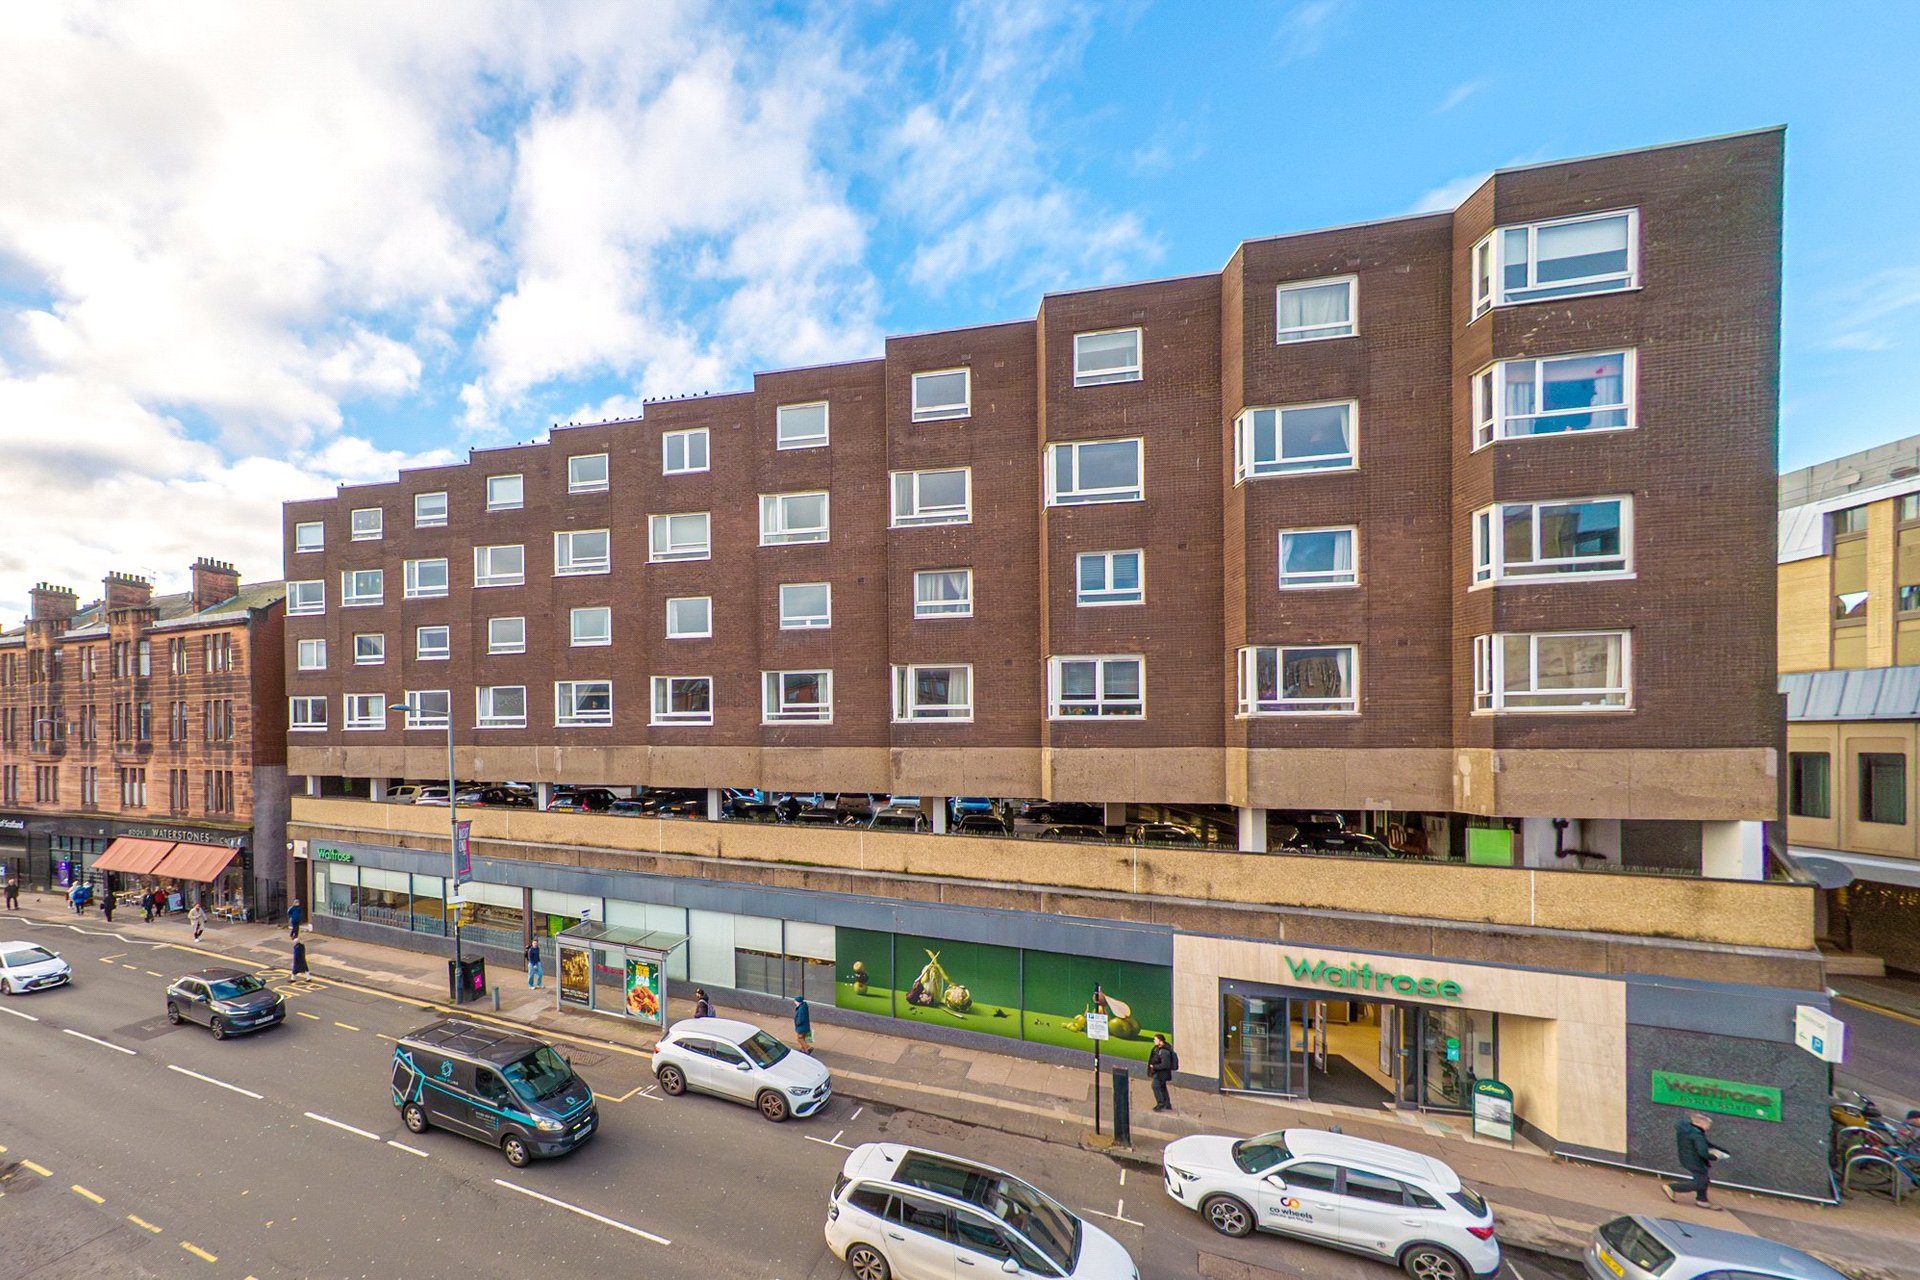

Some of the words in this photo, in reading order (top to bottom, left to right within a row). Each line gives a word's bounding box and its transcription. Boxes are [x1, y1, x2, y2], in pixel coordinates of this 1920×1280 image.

[151, 828, 209, 842] WATERSTONES
[317, 848, 353, 862] Waitrose
[1284, 955, 1463, 1001] Waitrose
[1663, 1078, 1773, 1106] Waitrose
[1281, 1209, 1313, 1219] wheels
